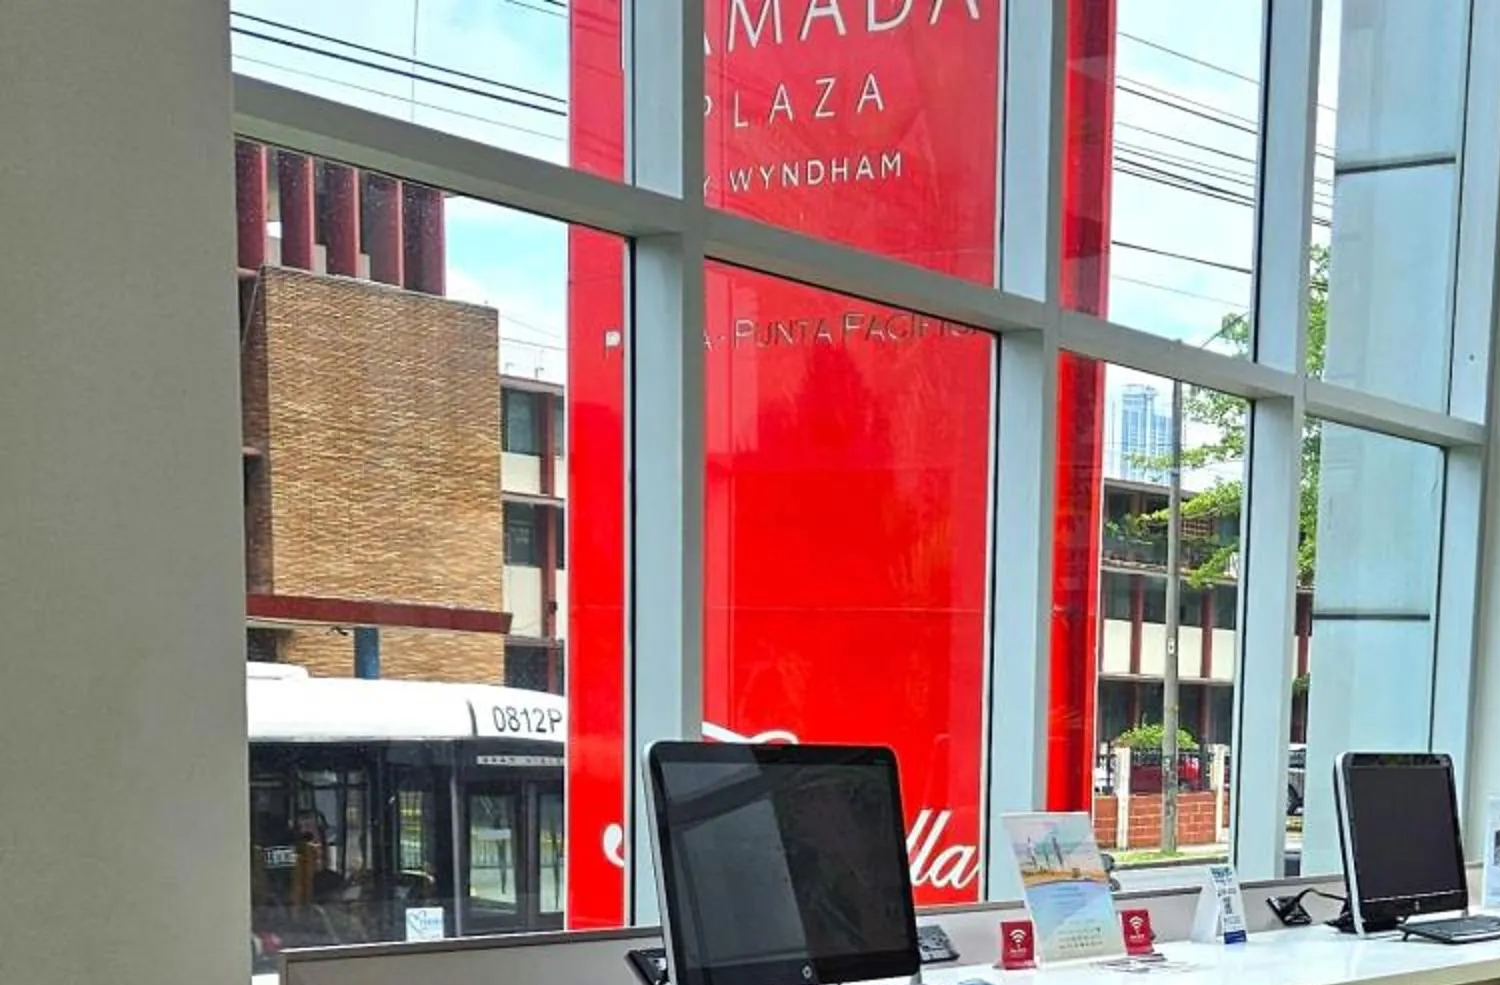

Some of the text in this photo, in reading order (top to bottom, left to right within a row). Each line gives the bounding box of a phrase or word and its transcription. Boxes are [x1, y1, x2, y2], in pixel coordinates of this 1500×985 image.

[729, 151, 901, 193] WYNDHAM
[734, 310, 978, 349] PUNTA PACIFI
[492, 705, 562, 733] 0812P
